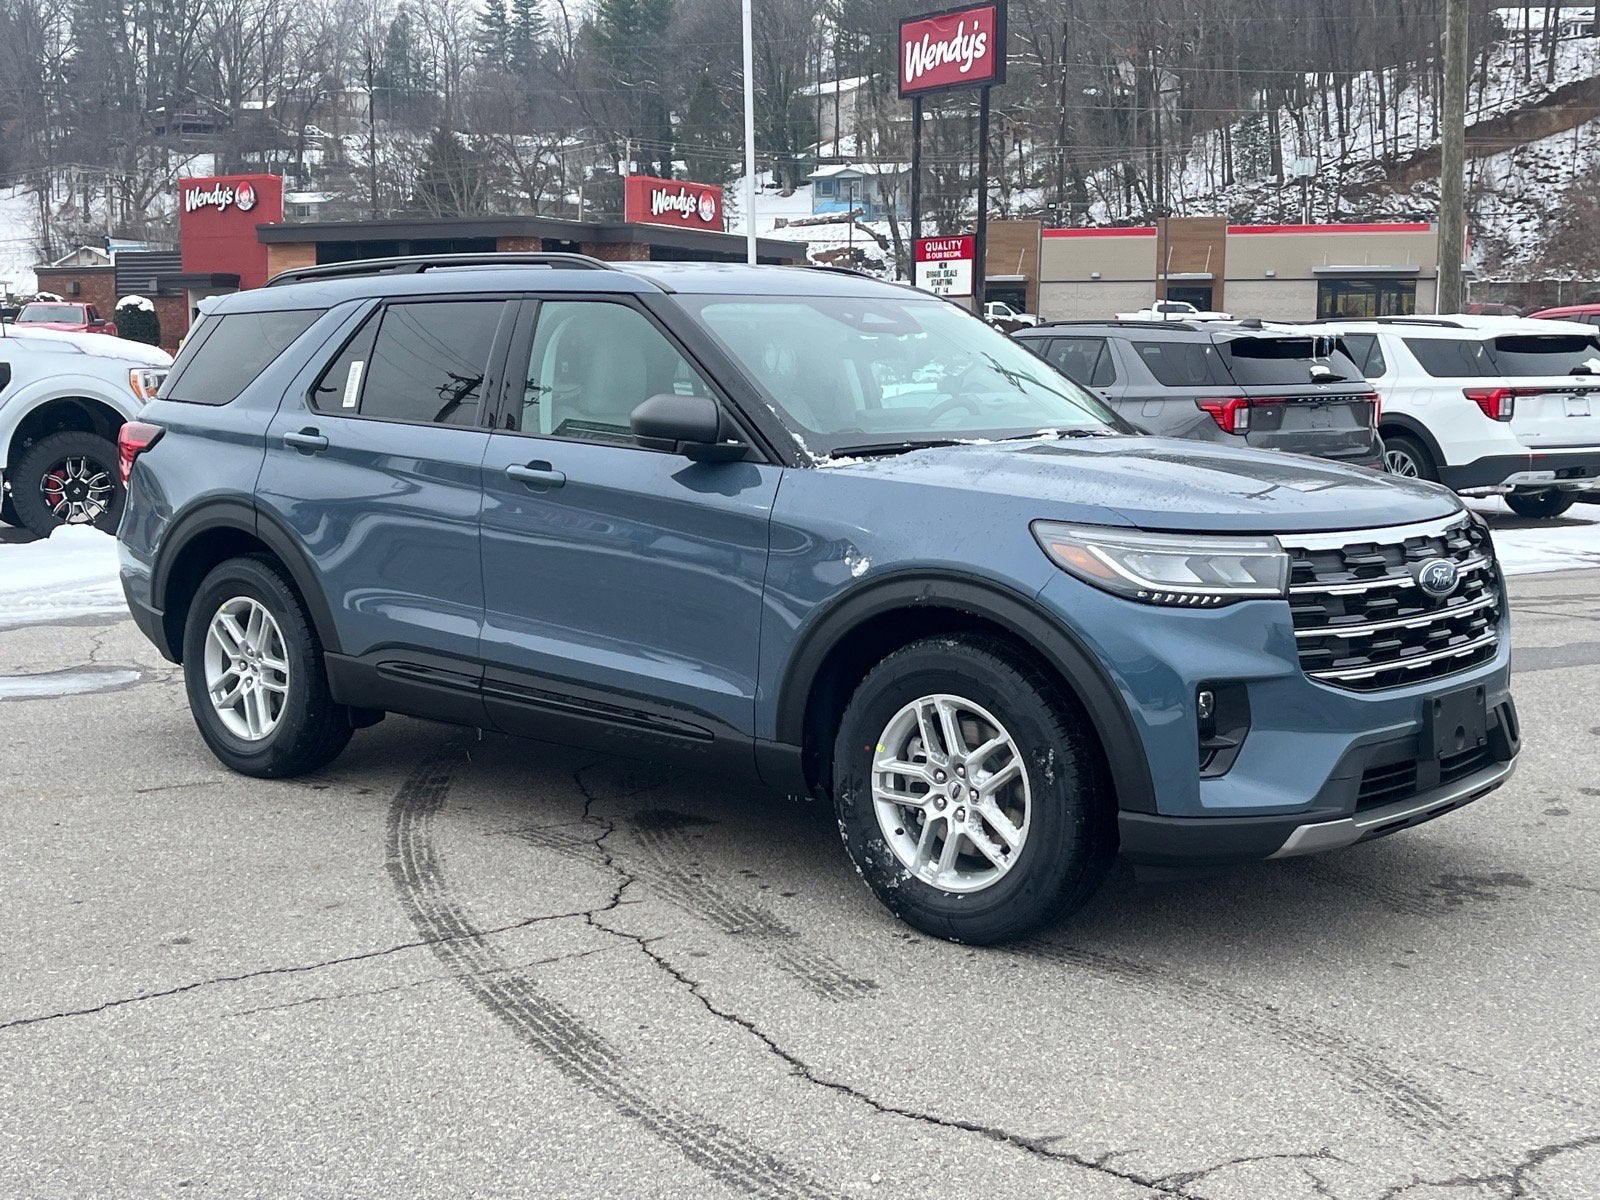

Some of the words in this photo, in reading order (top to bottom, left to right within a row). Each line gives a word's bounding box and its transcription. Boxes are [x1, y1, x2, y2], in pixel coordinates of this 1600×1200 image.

[905, 20, 987, 83] Wendy's
[185, 182, 234, 213] Wendy's
[652, 187, 697, 219] Wendy's
[925, 240, 963, 252] QUALITY
[931, 278, 952, 286] STARTING
